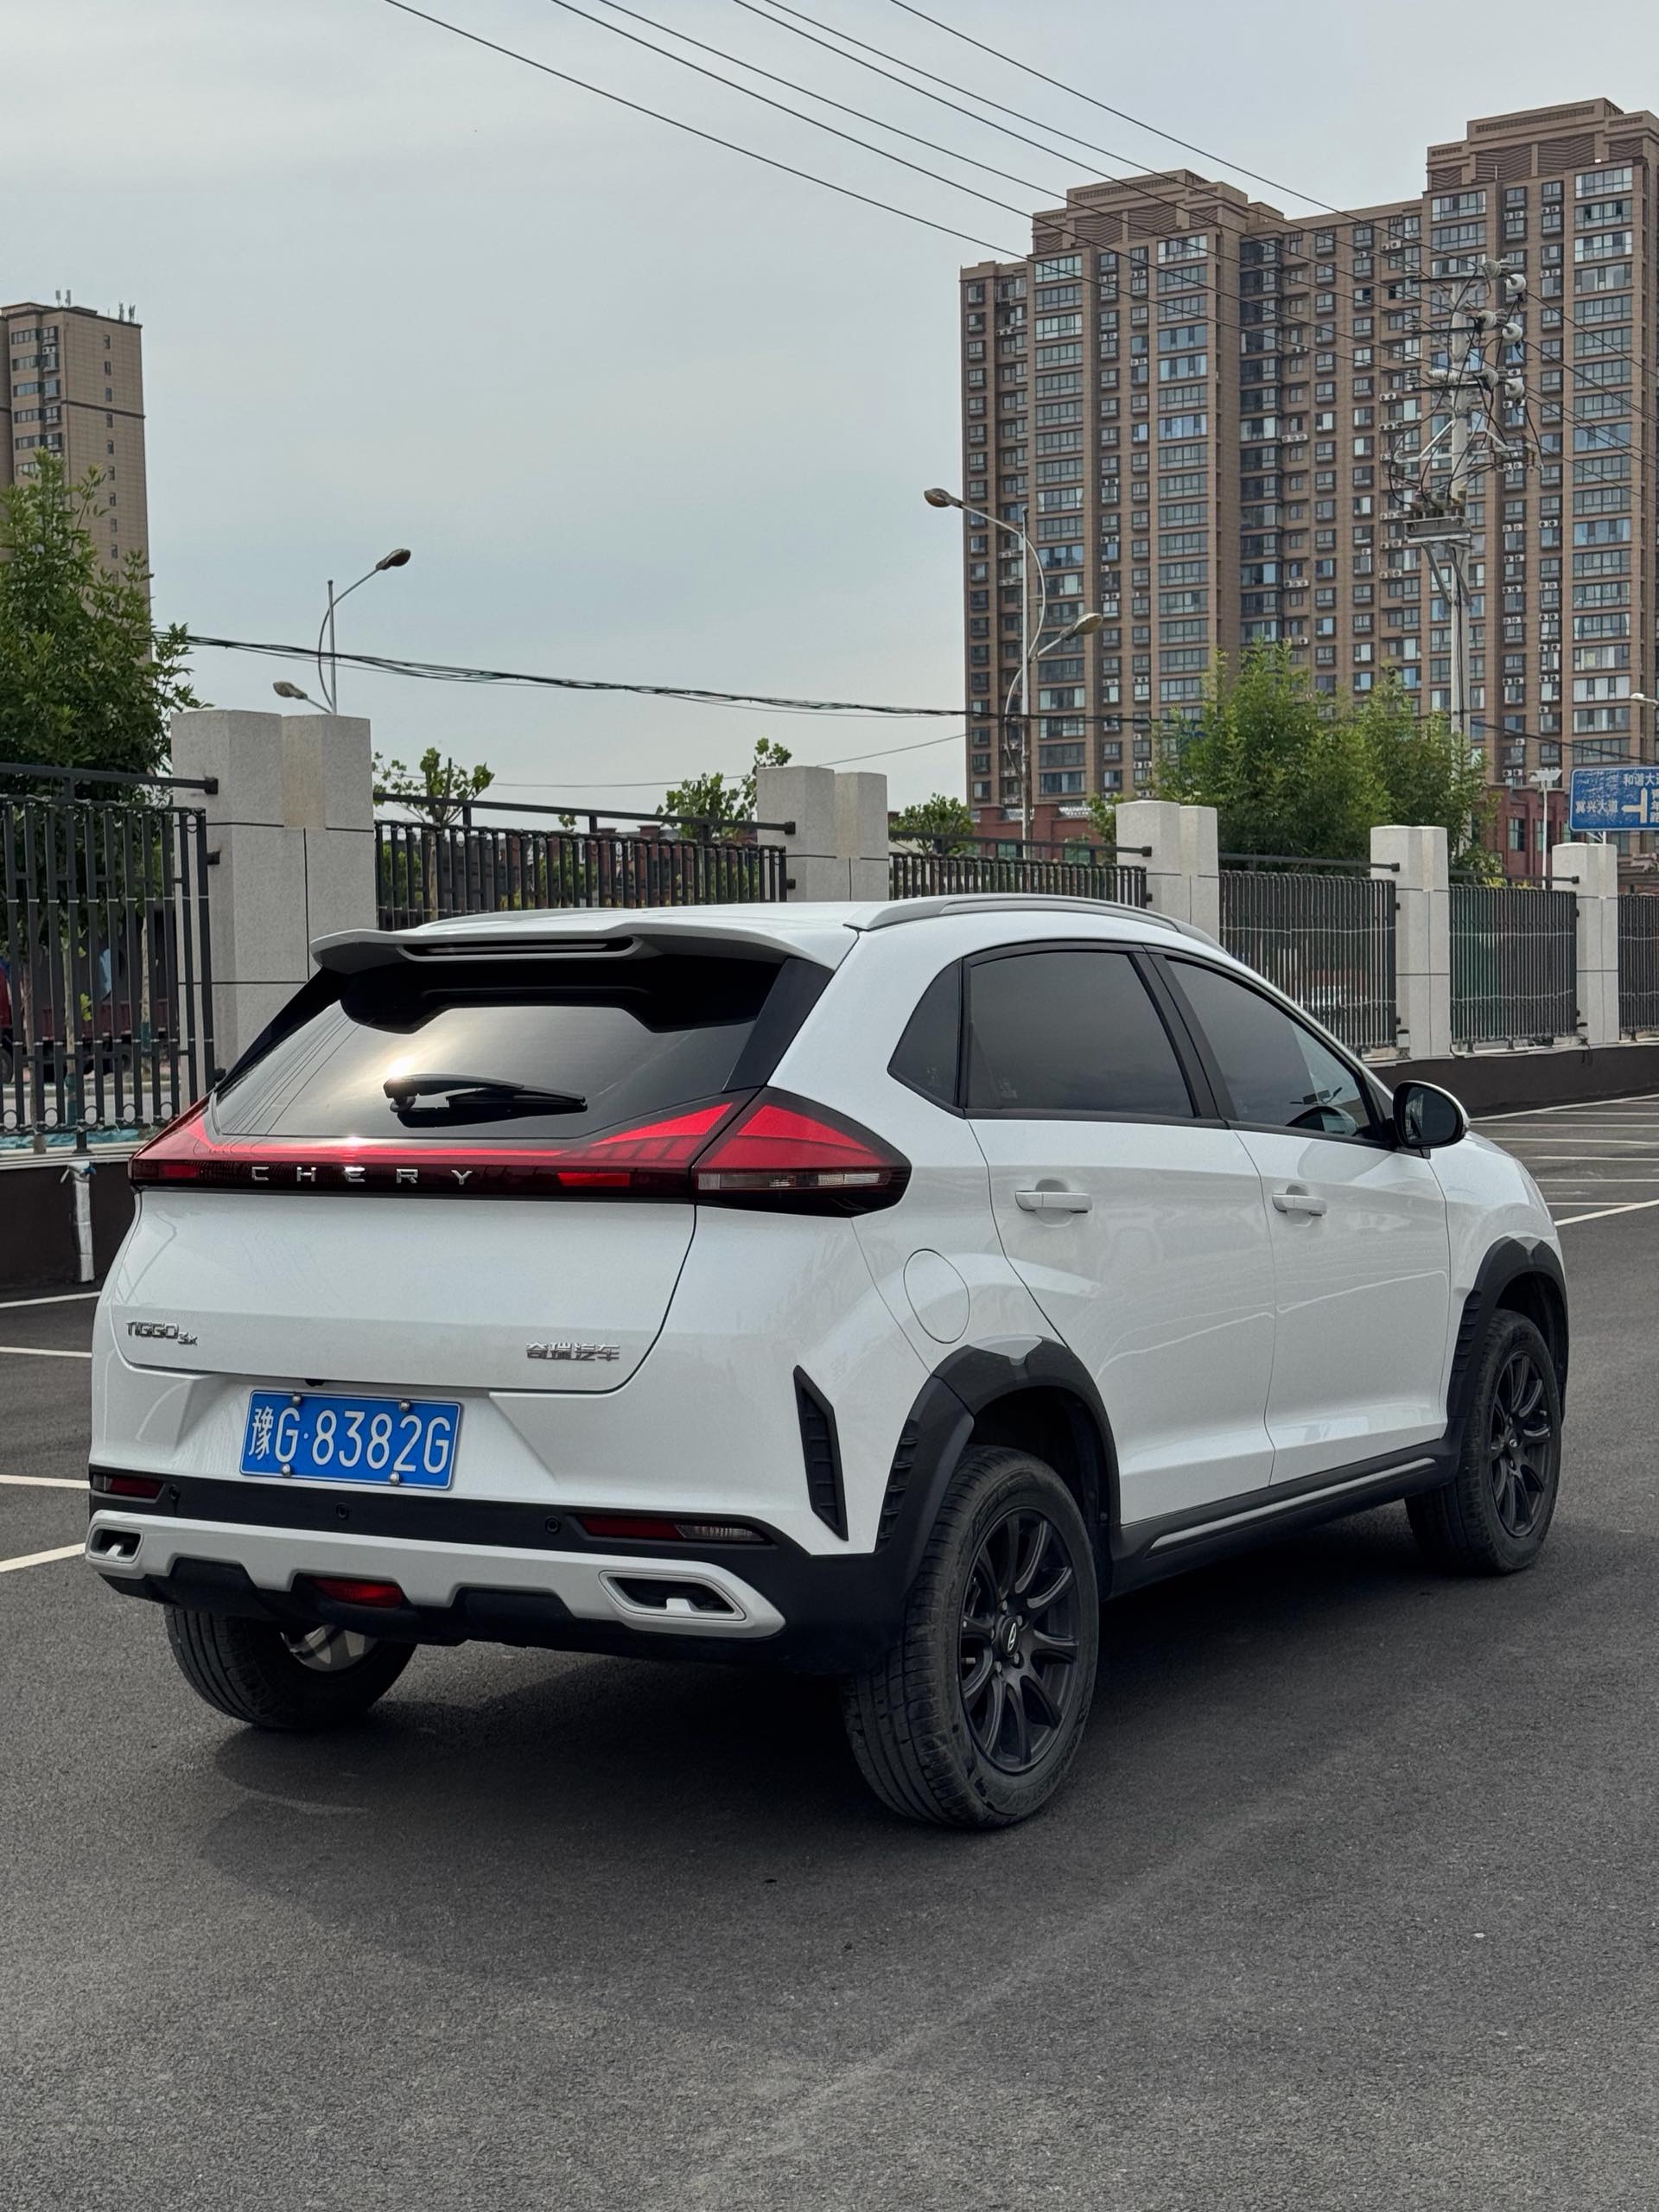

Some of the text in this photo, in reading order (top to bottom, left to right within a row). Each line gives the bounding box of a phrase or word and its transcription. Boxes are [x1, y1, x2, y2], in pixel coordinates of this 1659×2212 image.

[1623, 772, 1659, 786] 和谐大
[251, 1166, 473, 1185] CHERY
[125, 1321, 179, 1339] TIGGO
[526, 1342, 620, 1362] 奇瑞汽车
[248, 1405, 451, 1474] 豫G·8382G
